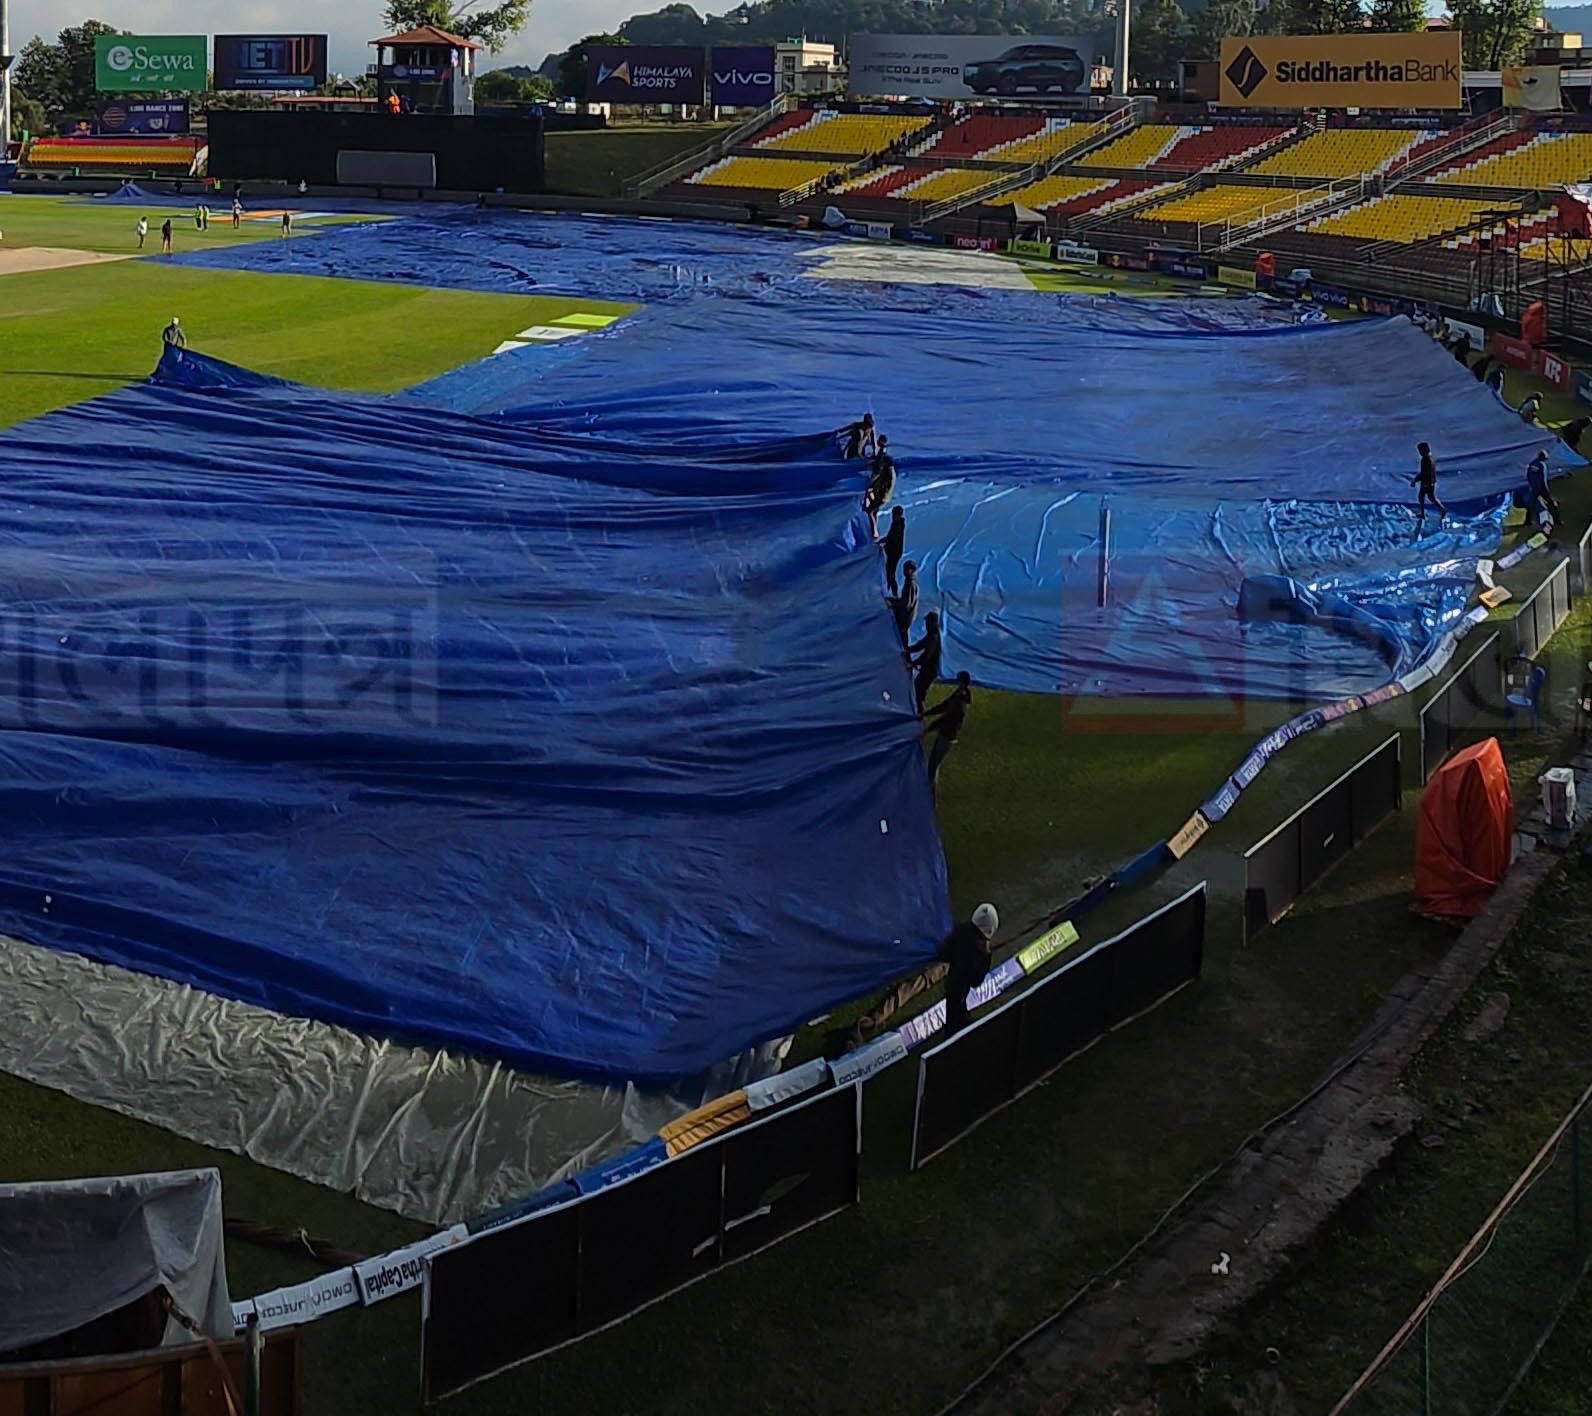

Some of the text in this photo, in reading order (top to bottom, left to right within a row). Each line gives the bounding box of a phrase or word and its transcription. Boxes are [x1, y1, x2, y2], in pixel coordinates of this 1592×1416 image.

[107, 45, 195, 71] eSewa
[632, 64, 694, 79] HIMALAYA
[714, 69, 773, 85] vivo
[631, 75, 678, 89] SPORTS
[1544, 356, 1561, 383] KFC
